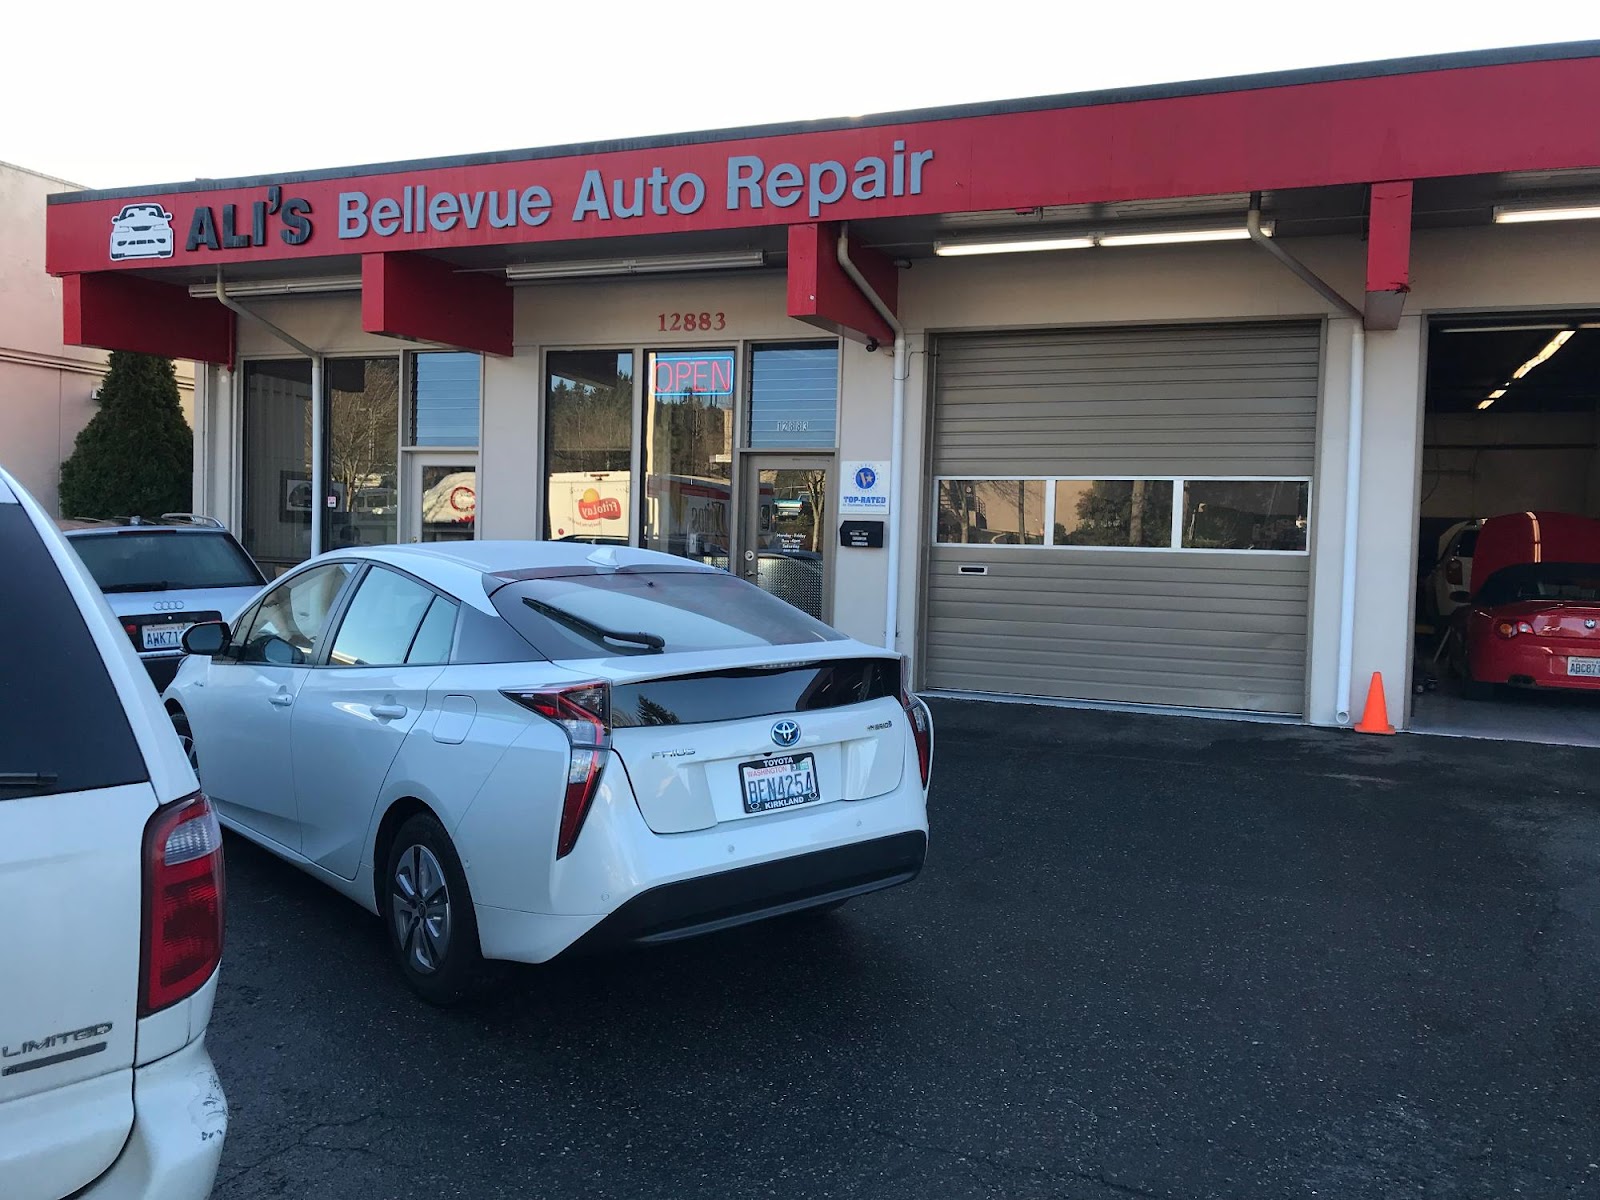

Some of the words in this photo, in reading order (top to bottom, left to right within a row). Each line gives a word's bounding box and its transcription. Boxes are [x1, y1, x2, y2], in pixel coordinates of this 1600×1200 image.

[185, 186, 314, 252] ALI'S
[338, 184, 552, 240] Bellevue
[572, 167, 705, 221] Auto
[727, 140, 934, 218] Repair
[657, 312, 727, 333] 12883
[654, 359, 732, 393] OPEN
[777, 421, 809, 432] 12883
[843, 496, 886, 504] TOP-RATED
[147, 631, 182, 646] AWK71
[763, 756, 794, 767] TOYOTA
[746, 765, 788, 778] WASHINGTON
[764, 796, 804, 810] KIRKLAND
[2, 1021, 113, 1058] LIMITED
